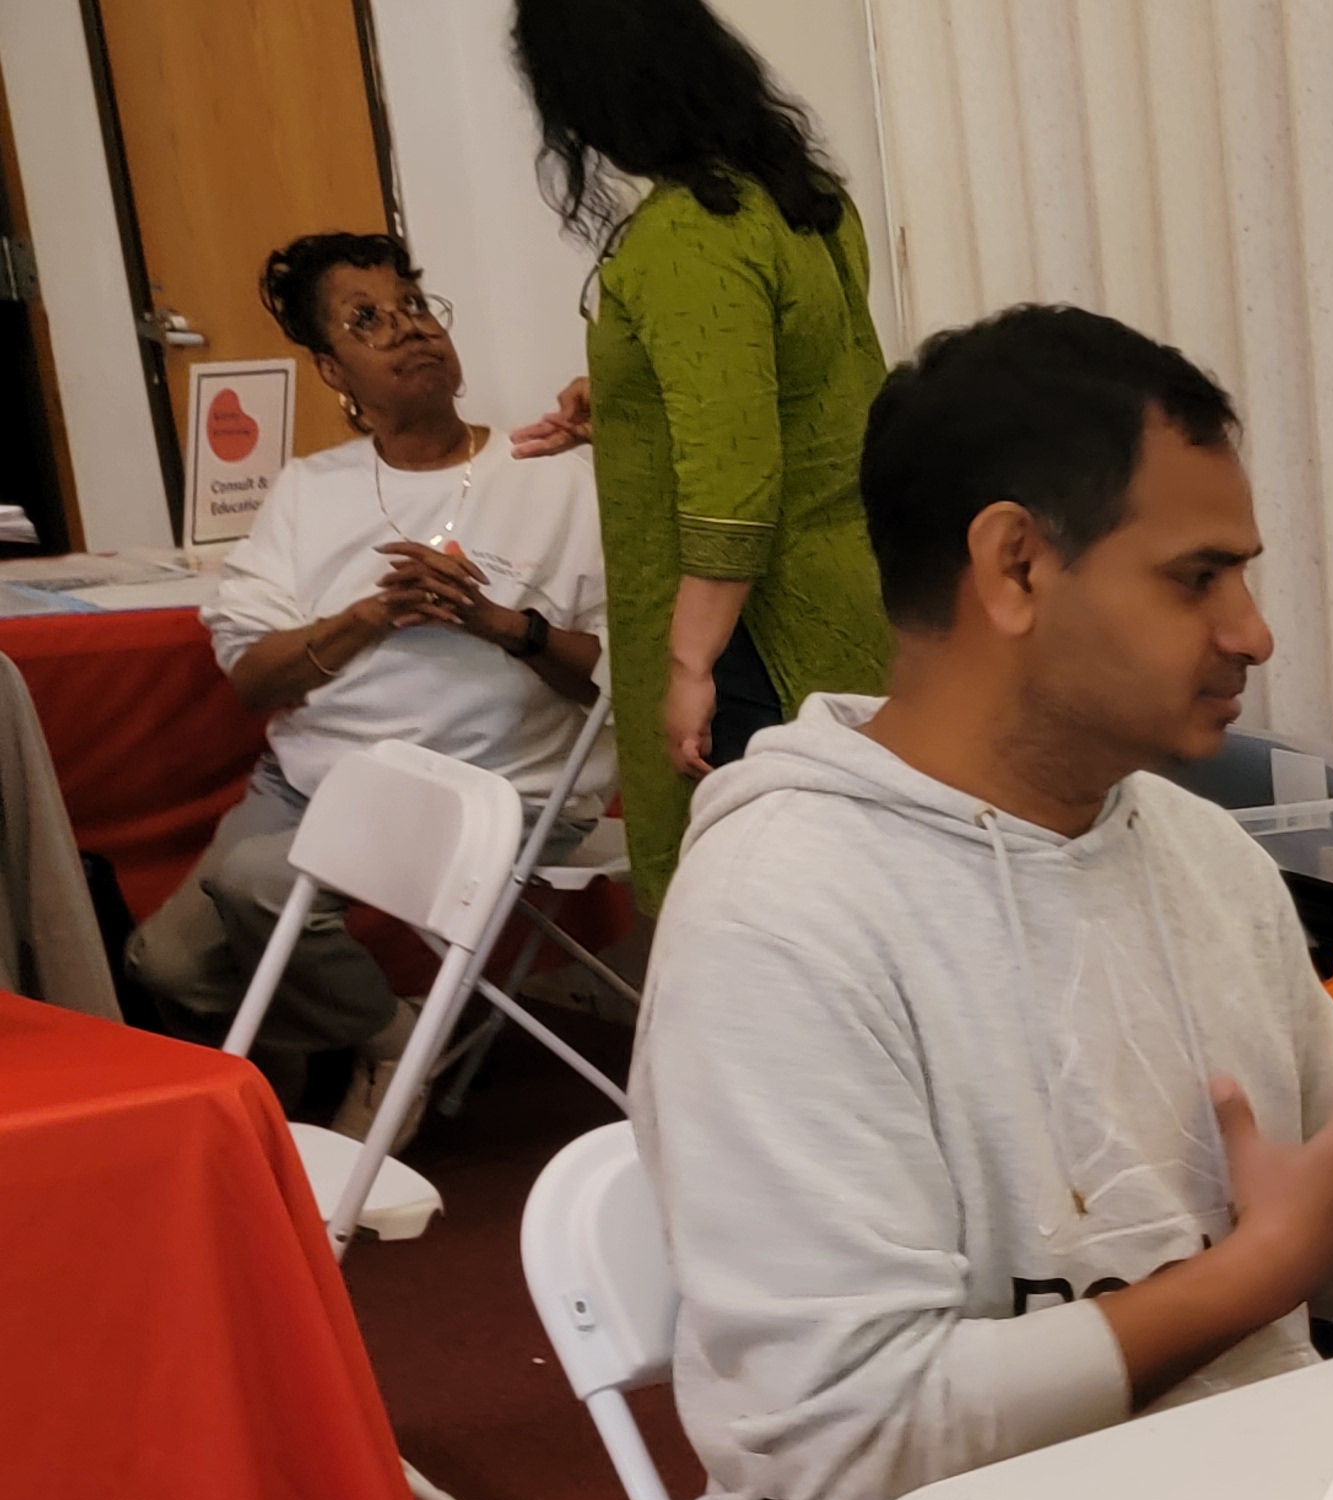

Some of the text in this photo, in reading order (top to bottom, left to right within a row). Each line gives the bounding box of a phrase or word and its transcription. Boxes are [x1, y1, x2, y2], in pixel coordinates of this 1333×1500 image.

[210, 475, 268, 495] Consult &
[210, 499, 263, 517] Educatio
